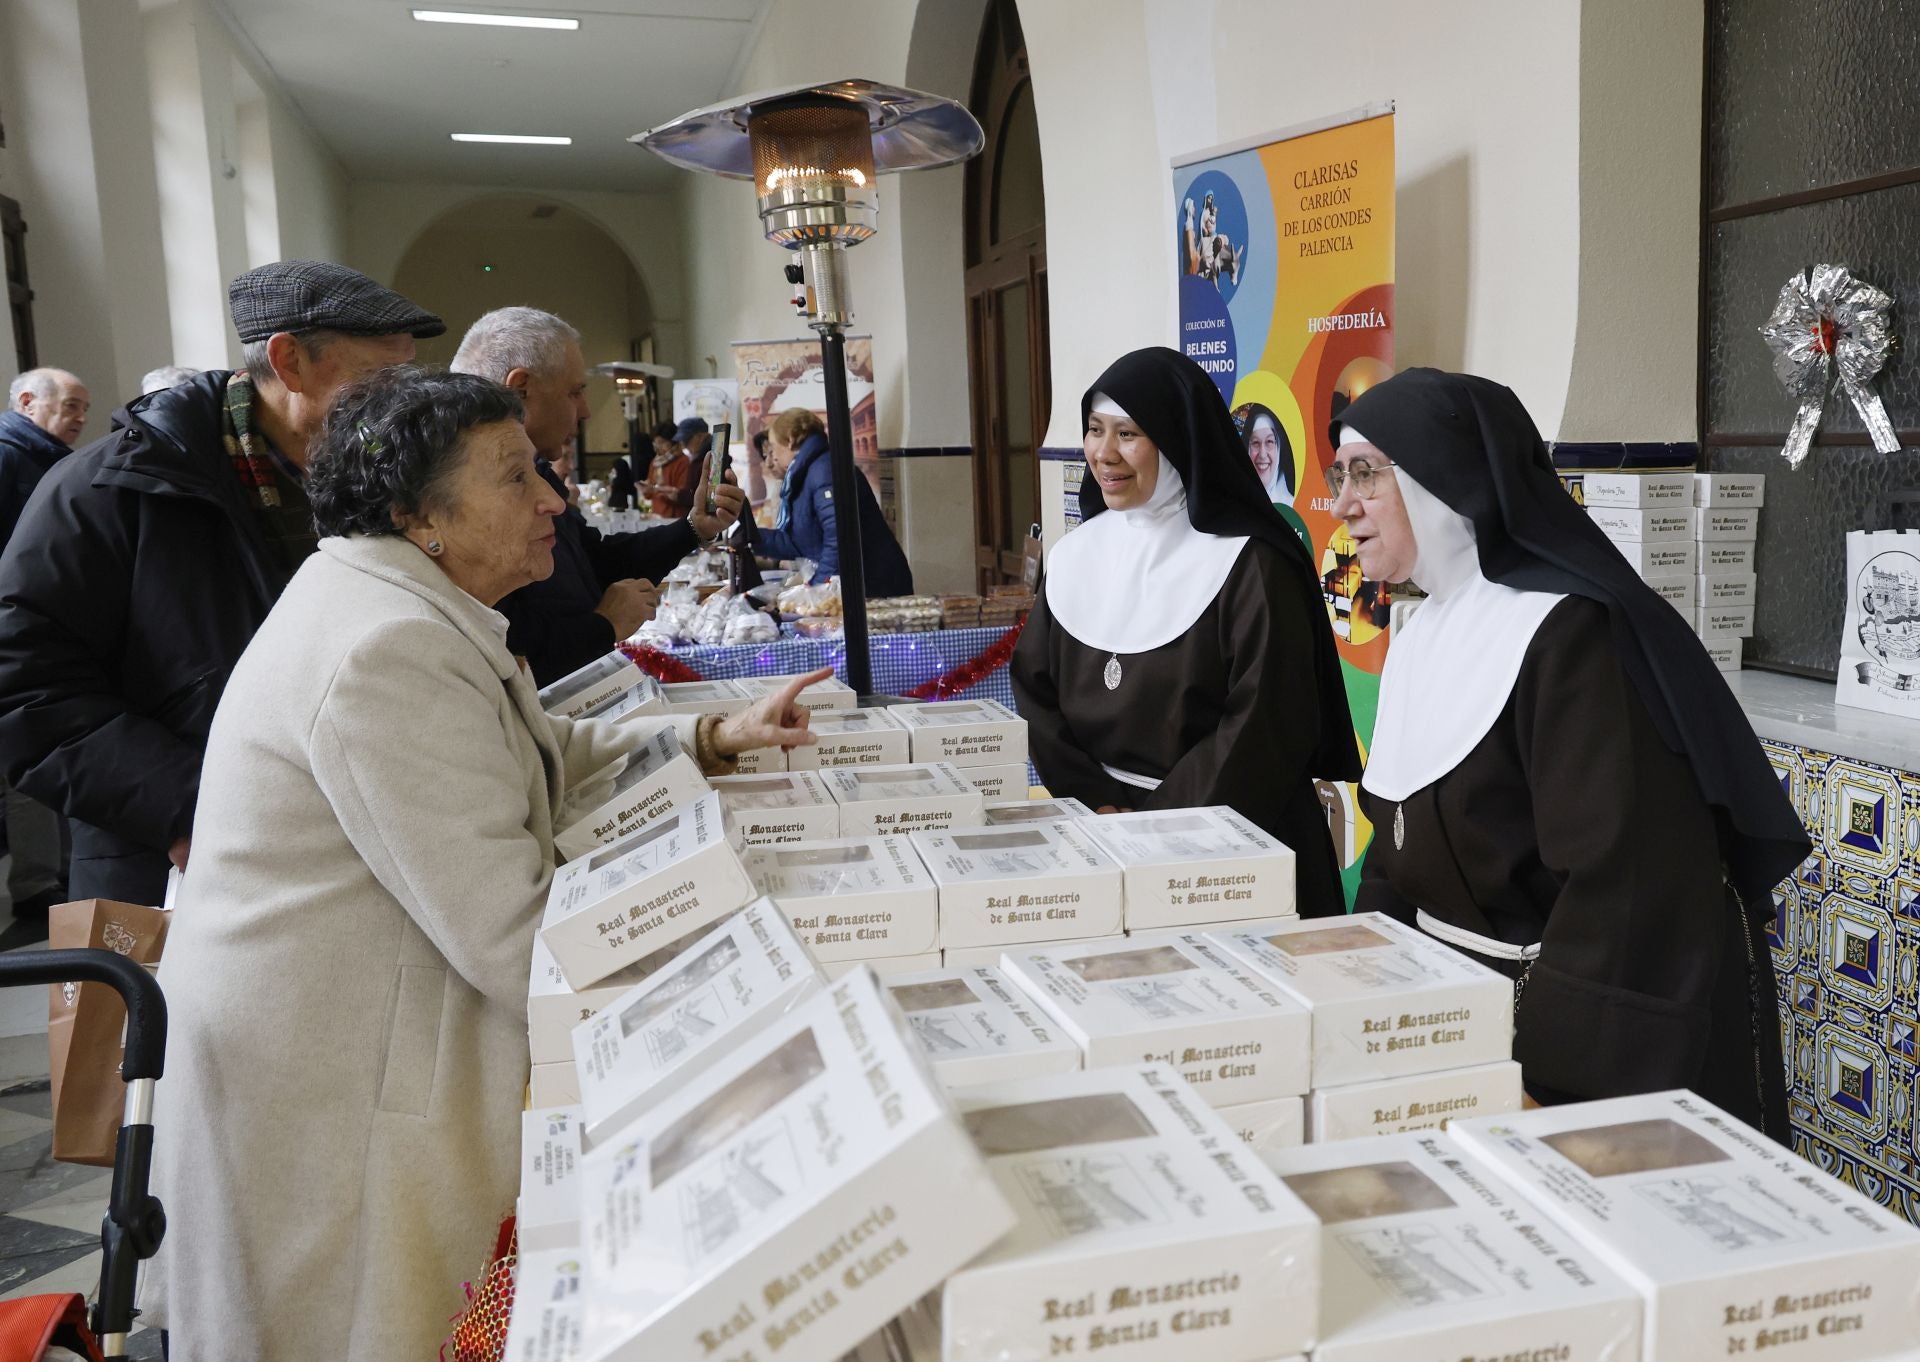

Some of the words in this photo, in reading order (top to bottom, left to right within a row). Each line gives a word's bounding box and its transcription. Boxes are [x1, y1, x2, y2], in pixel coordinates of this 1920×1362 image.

[1294, 160, 1358, 189] CLARISAS
[1300, 186, 1352, 212] CARRIÓN
[1284, 221, 1298, 237] DE
[1302, 217, 1322, 235] LOS
[1324, 208, 1372, 232] CONDES
[1300, 235, 1353, 257] PALENCIA
[1186, 318, 1215, 331] COLECCIÓN
[1217, 319, 1225, 327] DE
[1307, 308, 1385, 333] HOSPEDERÍA
[1186, 341, 1227, 356] BELENES
[584, 685, 622, 709] Monasterio
[817, 746, 835, 756] Real
[838, 743, 882, 754] Monasterio
[941, 736, 958, 746] Real
[960, 733, 1003, 745] Monasterio
[944, 748, 952, 756] de
[954, 746, 978, 755] Santa
[980, 743, 1001, 753] Clara
[821, 758, 830, 766] de
[832, 756, 857, 765] Santa
[859, 753, 880, 763] Clara
[592, 818, 616, 840] Real
[617, 786, 669, 824] Monasterio
[647, 799, 674, 820] Clara
[874, 814, 896, 824] Real
[900, 810, 952, 823] Monasterio
[749, 822, 804, 835] Monasterio
[1167, 877, 1192, 890] Real
[1195, 873, 1256, 888] Monasterio
[596, 914, 626, 936] Real
[629, 879, 696, 922] Monasterio
[986, 896, 1012, 909] Real
[1016, 892, 1080, 907] Monasterio
[1171, 893, 1183, 904] de
[1187, 891, 1220, 904] Santa
[1223, 889, 1252, 900] Clara
[608, 934, 624, 948] de
[627, 917, 665, 940] Santa
[666, 897, 700, 918] Clara
[792, 916, 819, 930] Real
[824, 911, 892, 928] Monasterio
[990, 913, 1002, 924] de
[1008, 911, 1042, 923] Santa
[1046, 908, 1076, 920] Clara
[815, 931, 852, 945] Santa
[856, 928, 888, 941] Clara
[1361, 1016, 1391, 1034] Real
[1396, 1007, 1471, 1029] Monasterio
[1366, 1039, 1380, 1054] de
[1386, 1032, 1426, 1053] Santa
[1431, 1027, 1465, 1044] Clara
[1181, 1041, 1262, 1064] Monasterio
[1218, 1062, 1256, 1080] Clara
[1373, 1104, 1400, 1124] Real
[1407, 1094, 1478, 1119] Monasterio
[696, 1302, 756, 1357] Real
[762, 1205, 896, 1312] Monasterio
[762, 1288, 840, 1353] Santa
[843, 1235, 909, 1289] Clara
[1042, 1291, 1095, 1324] Real
[1106, 1270, 1241, 1314] Monasterio
[1722, 1300, 1763, 1328] Real
[1771, 1282, 1873, 1318] Monasterio
[1049, 1331, 1074, 1356] de
[1088, 1319, 1159, 1352] Santa
[1170, 1306, 1232, 1334] Clara
[1726, 1334, 1747, 1355] de
[1752, 1322, 1808, 1352] Santa
[1815, 1311, 1864, 1338] Clara
